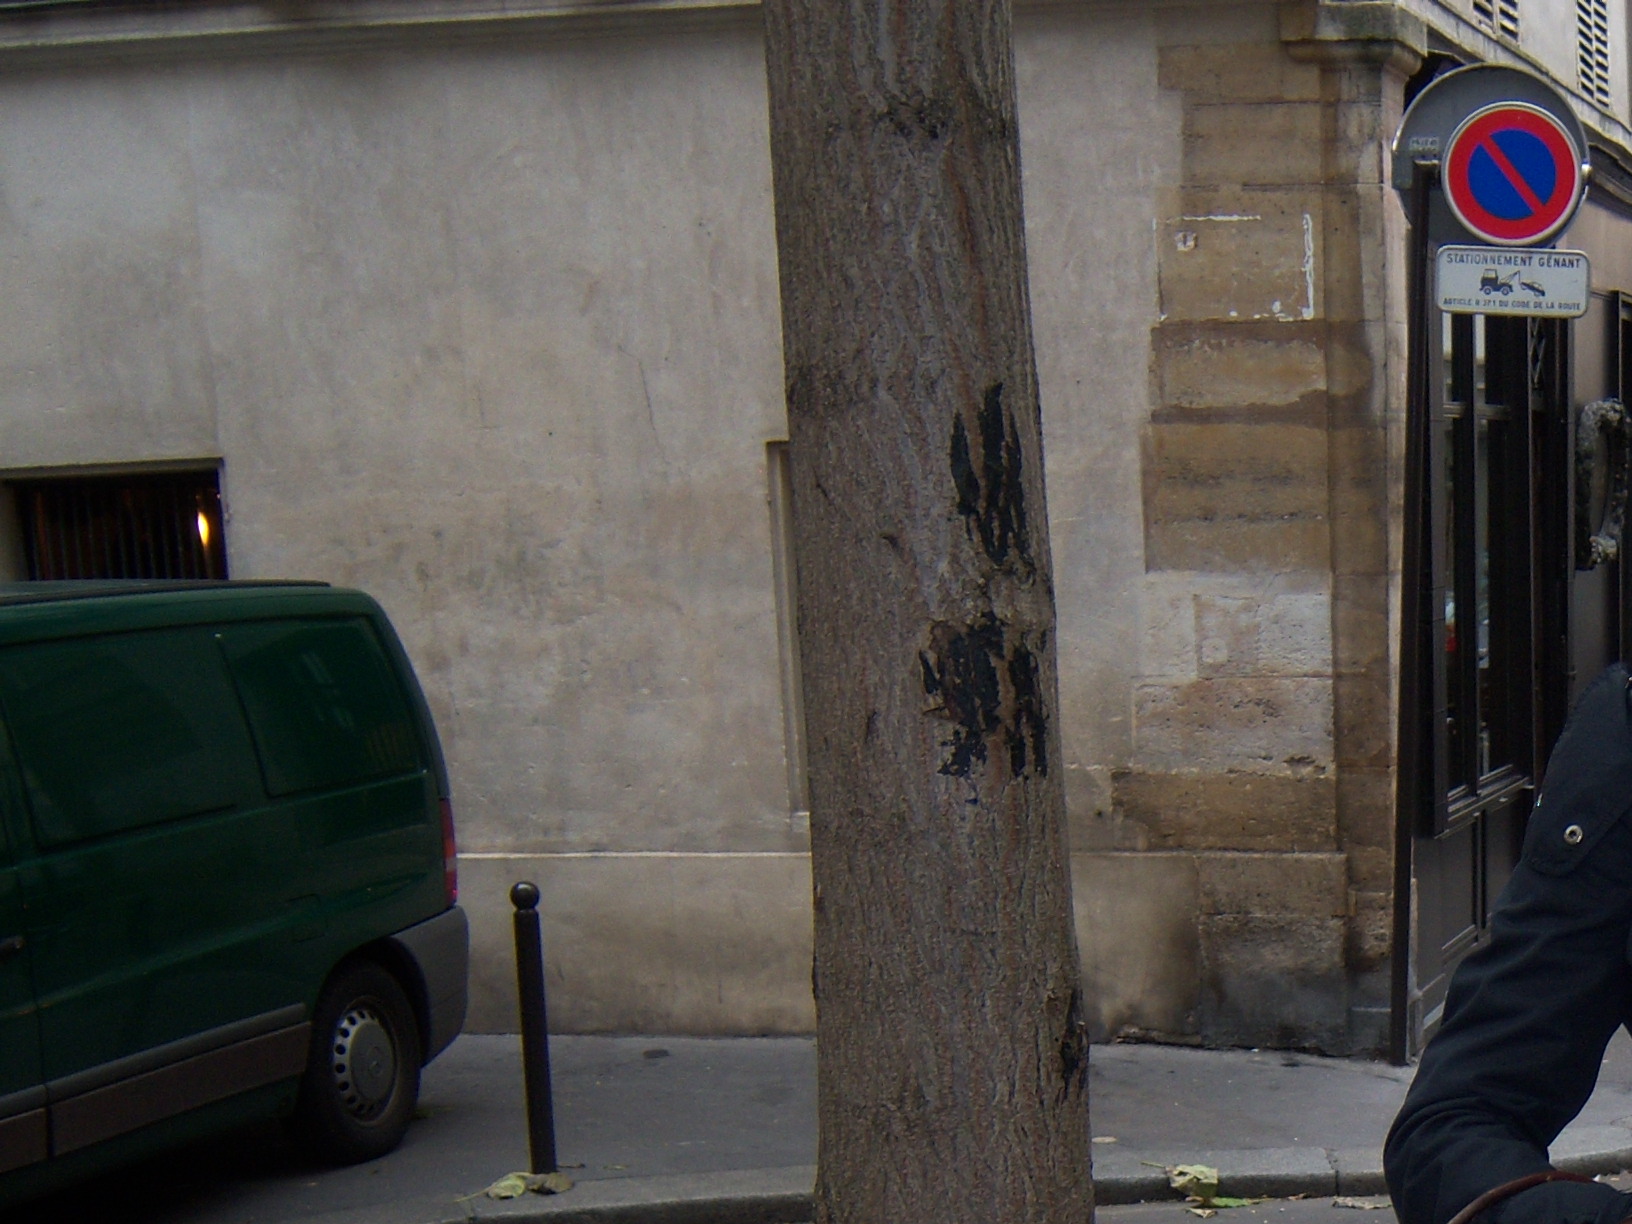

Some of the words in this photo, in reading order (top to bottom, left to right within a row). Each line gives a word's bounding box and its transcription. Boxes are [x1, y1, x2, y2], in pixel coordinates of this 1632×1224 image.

[1446, 252, 1533, 267] STATIONNEMENT
[1512, 300, 1530, 308] CODE
[1533, 300, 1543, 309] DE
[1545, 301, 1555, 309] LA
[1558, 302, 1580, 311] ROUTE
